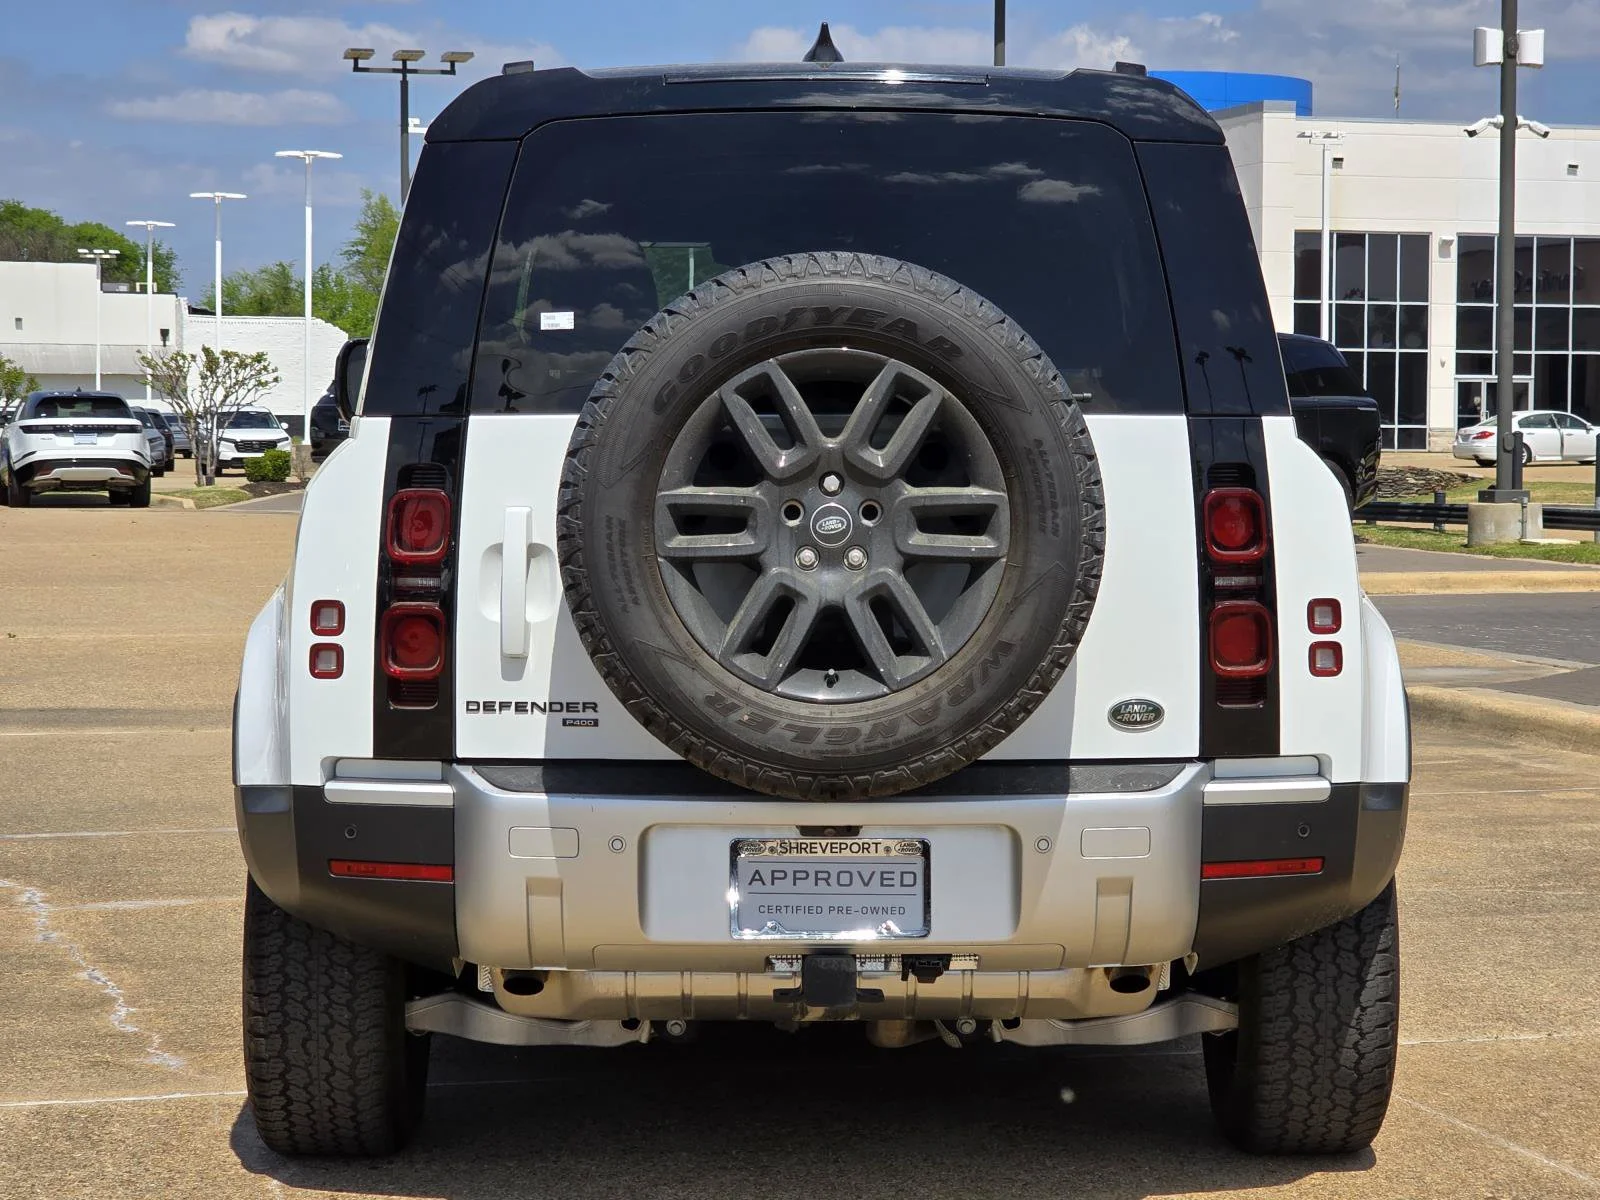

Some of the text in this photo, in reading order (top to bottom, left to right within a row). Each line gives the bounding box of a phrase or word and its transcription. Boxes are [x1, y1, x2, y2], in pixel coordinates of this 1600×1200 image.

[653, 306, 964, 415] GOODYEAR
[704, 639, 1016, 745] WRANGLER
[465, 700, 599, 714] DEFENDER
[778, 842, 882, 854] SHREVEPORT
[748, 869, 917, 888] APPROVED
[758, 904, 907, 916] CERTIFIED PRE-OWNED
